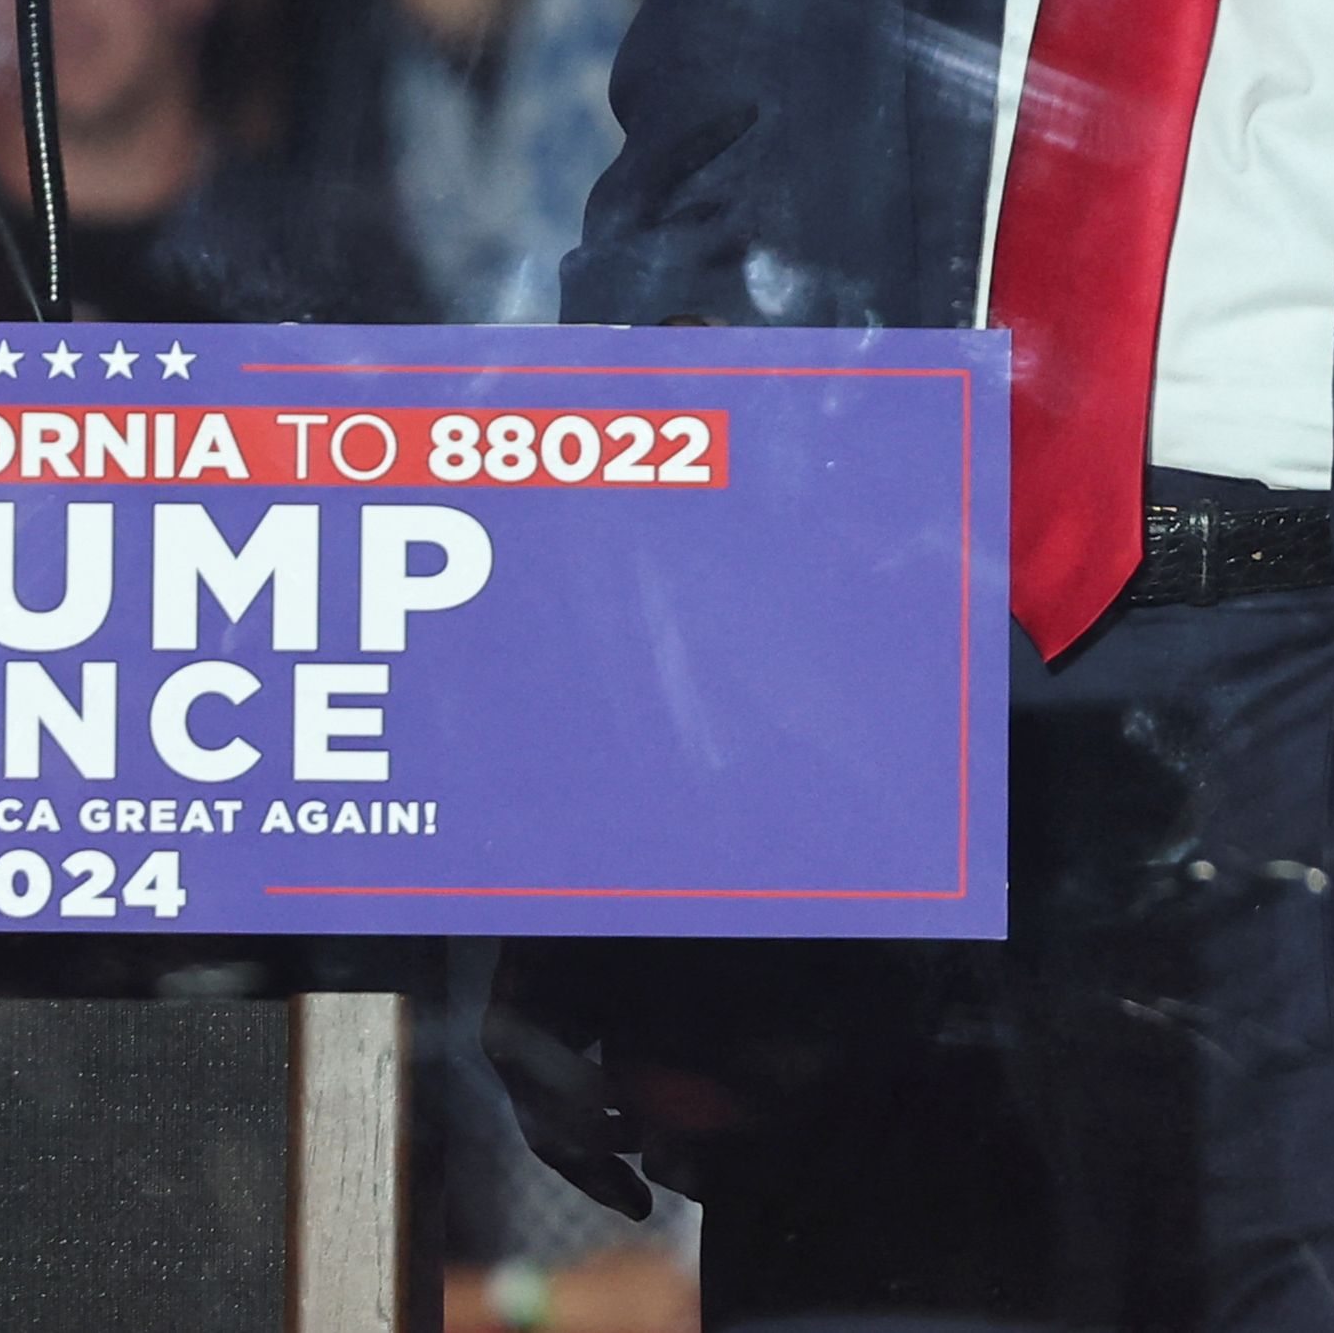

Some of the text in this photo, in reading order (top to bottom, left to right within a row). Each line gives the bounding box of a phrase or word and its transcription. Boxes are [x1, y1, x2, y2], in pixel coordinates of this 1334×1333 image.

[275, 413, 398, 481] TO
[427, 414, 712, 484] 88022
[78, 799, 243, 833] GREAT
[259, 801, 439, 835] AGAIN!
